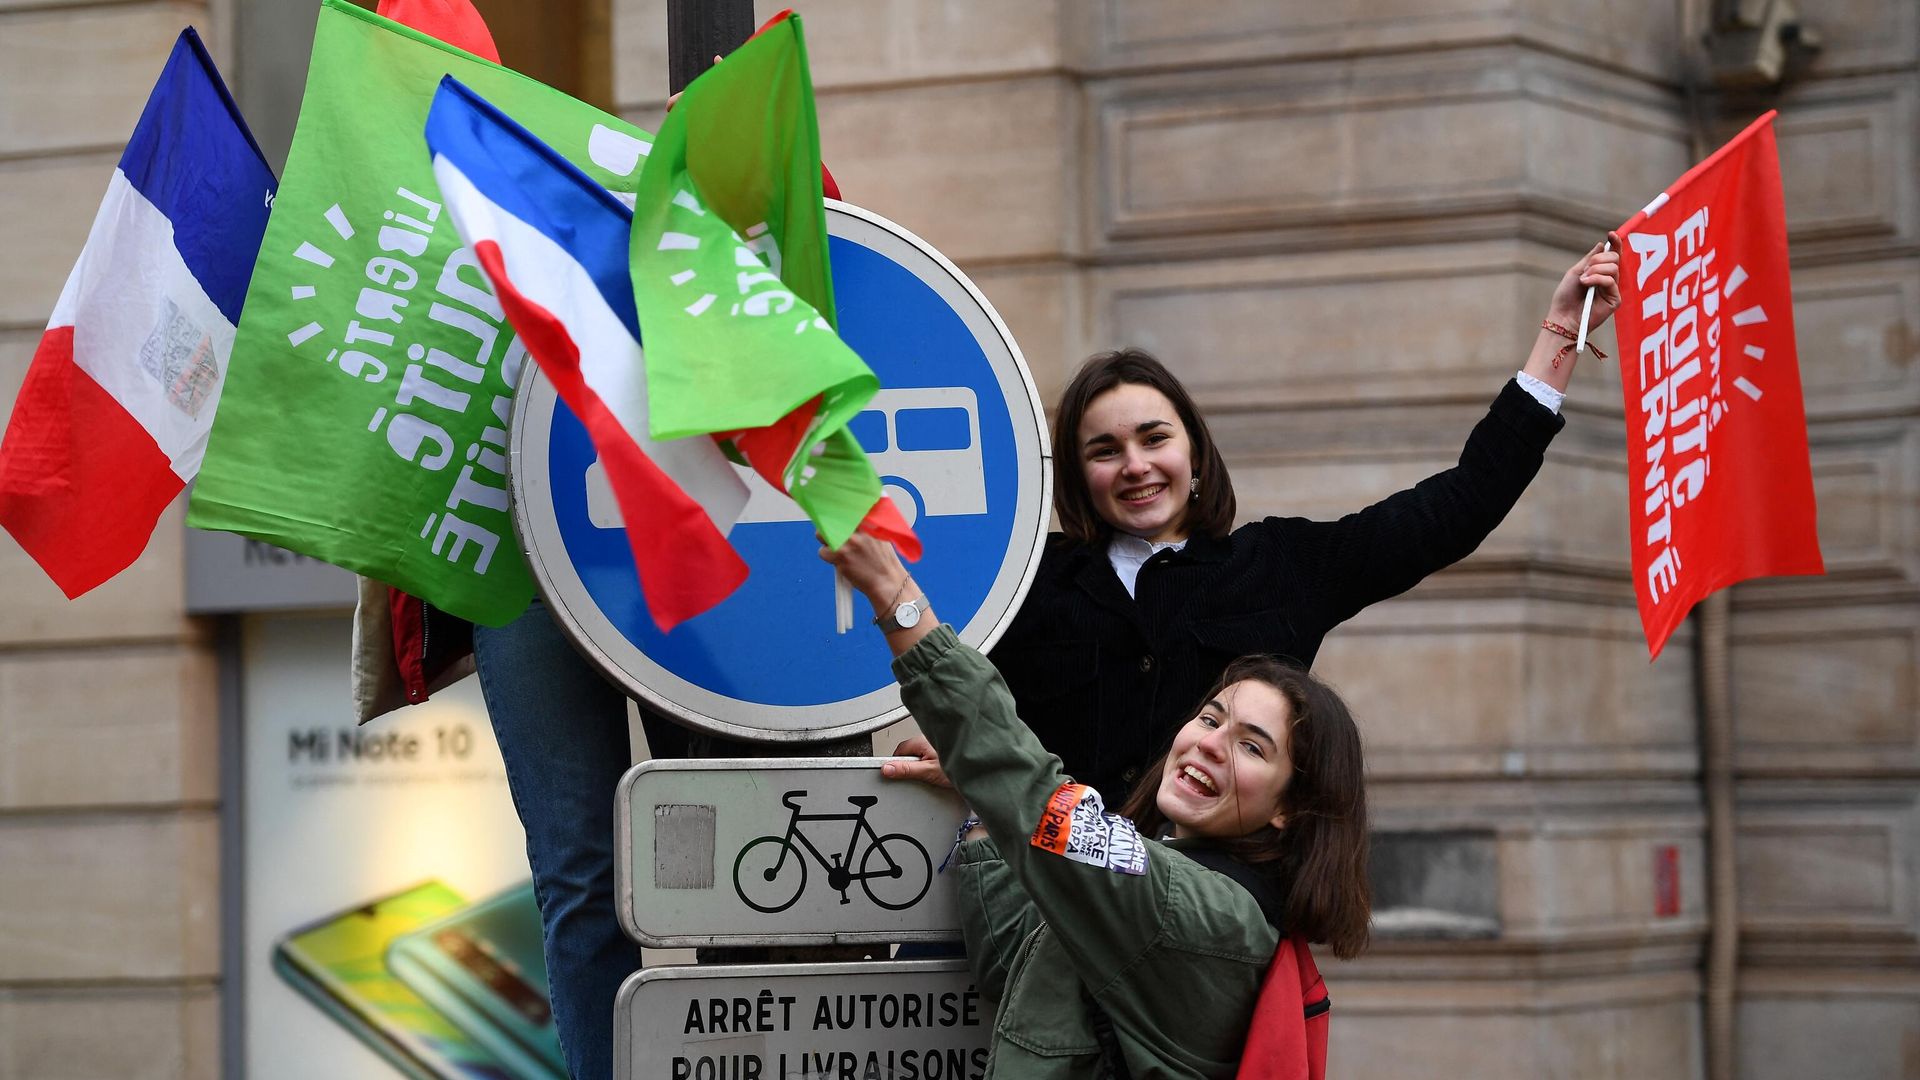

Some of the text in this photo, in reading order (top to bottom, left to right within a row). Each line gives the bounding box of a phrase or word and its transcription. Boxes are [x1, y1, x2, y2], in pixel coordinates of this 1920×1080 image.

[289, 723, 474, 763] Mi Note 10
[683, 985, 981, 1034] ARRÊT AUTORISÉ
[672, 1047, 989, 1080] POUR LIVRAISONS
